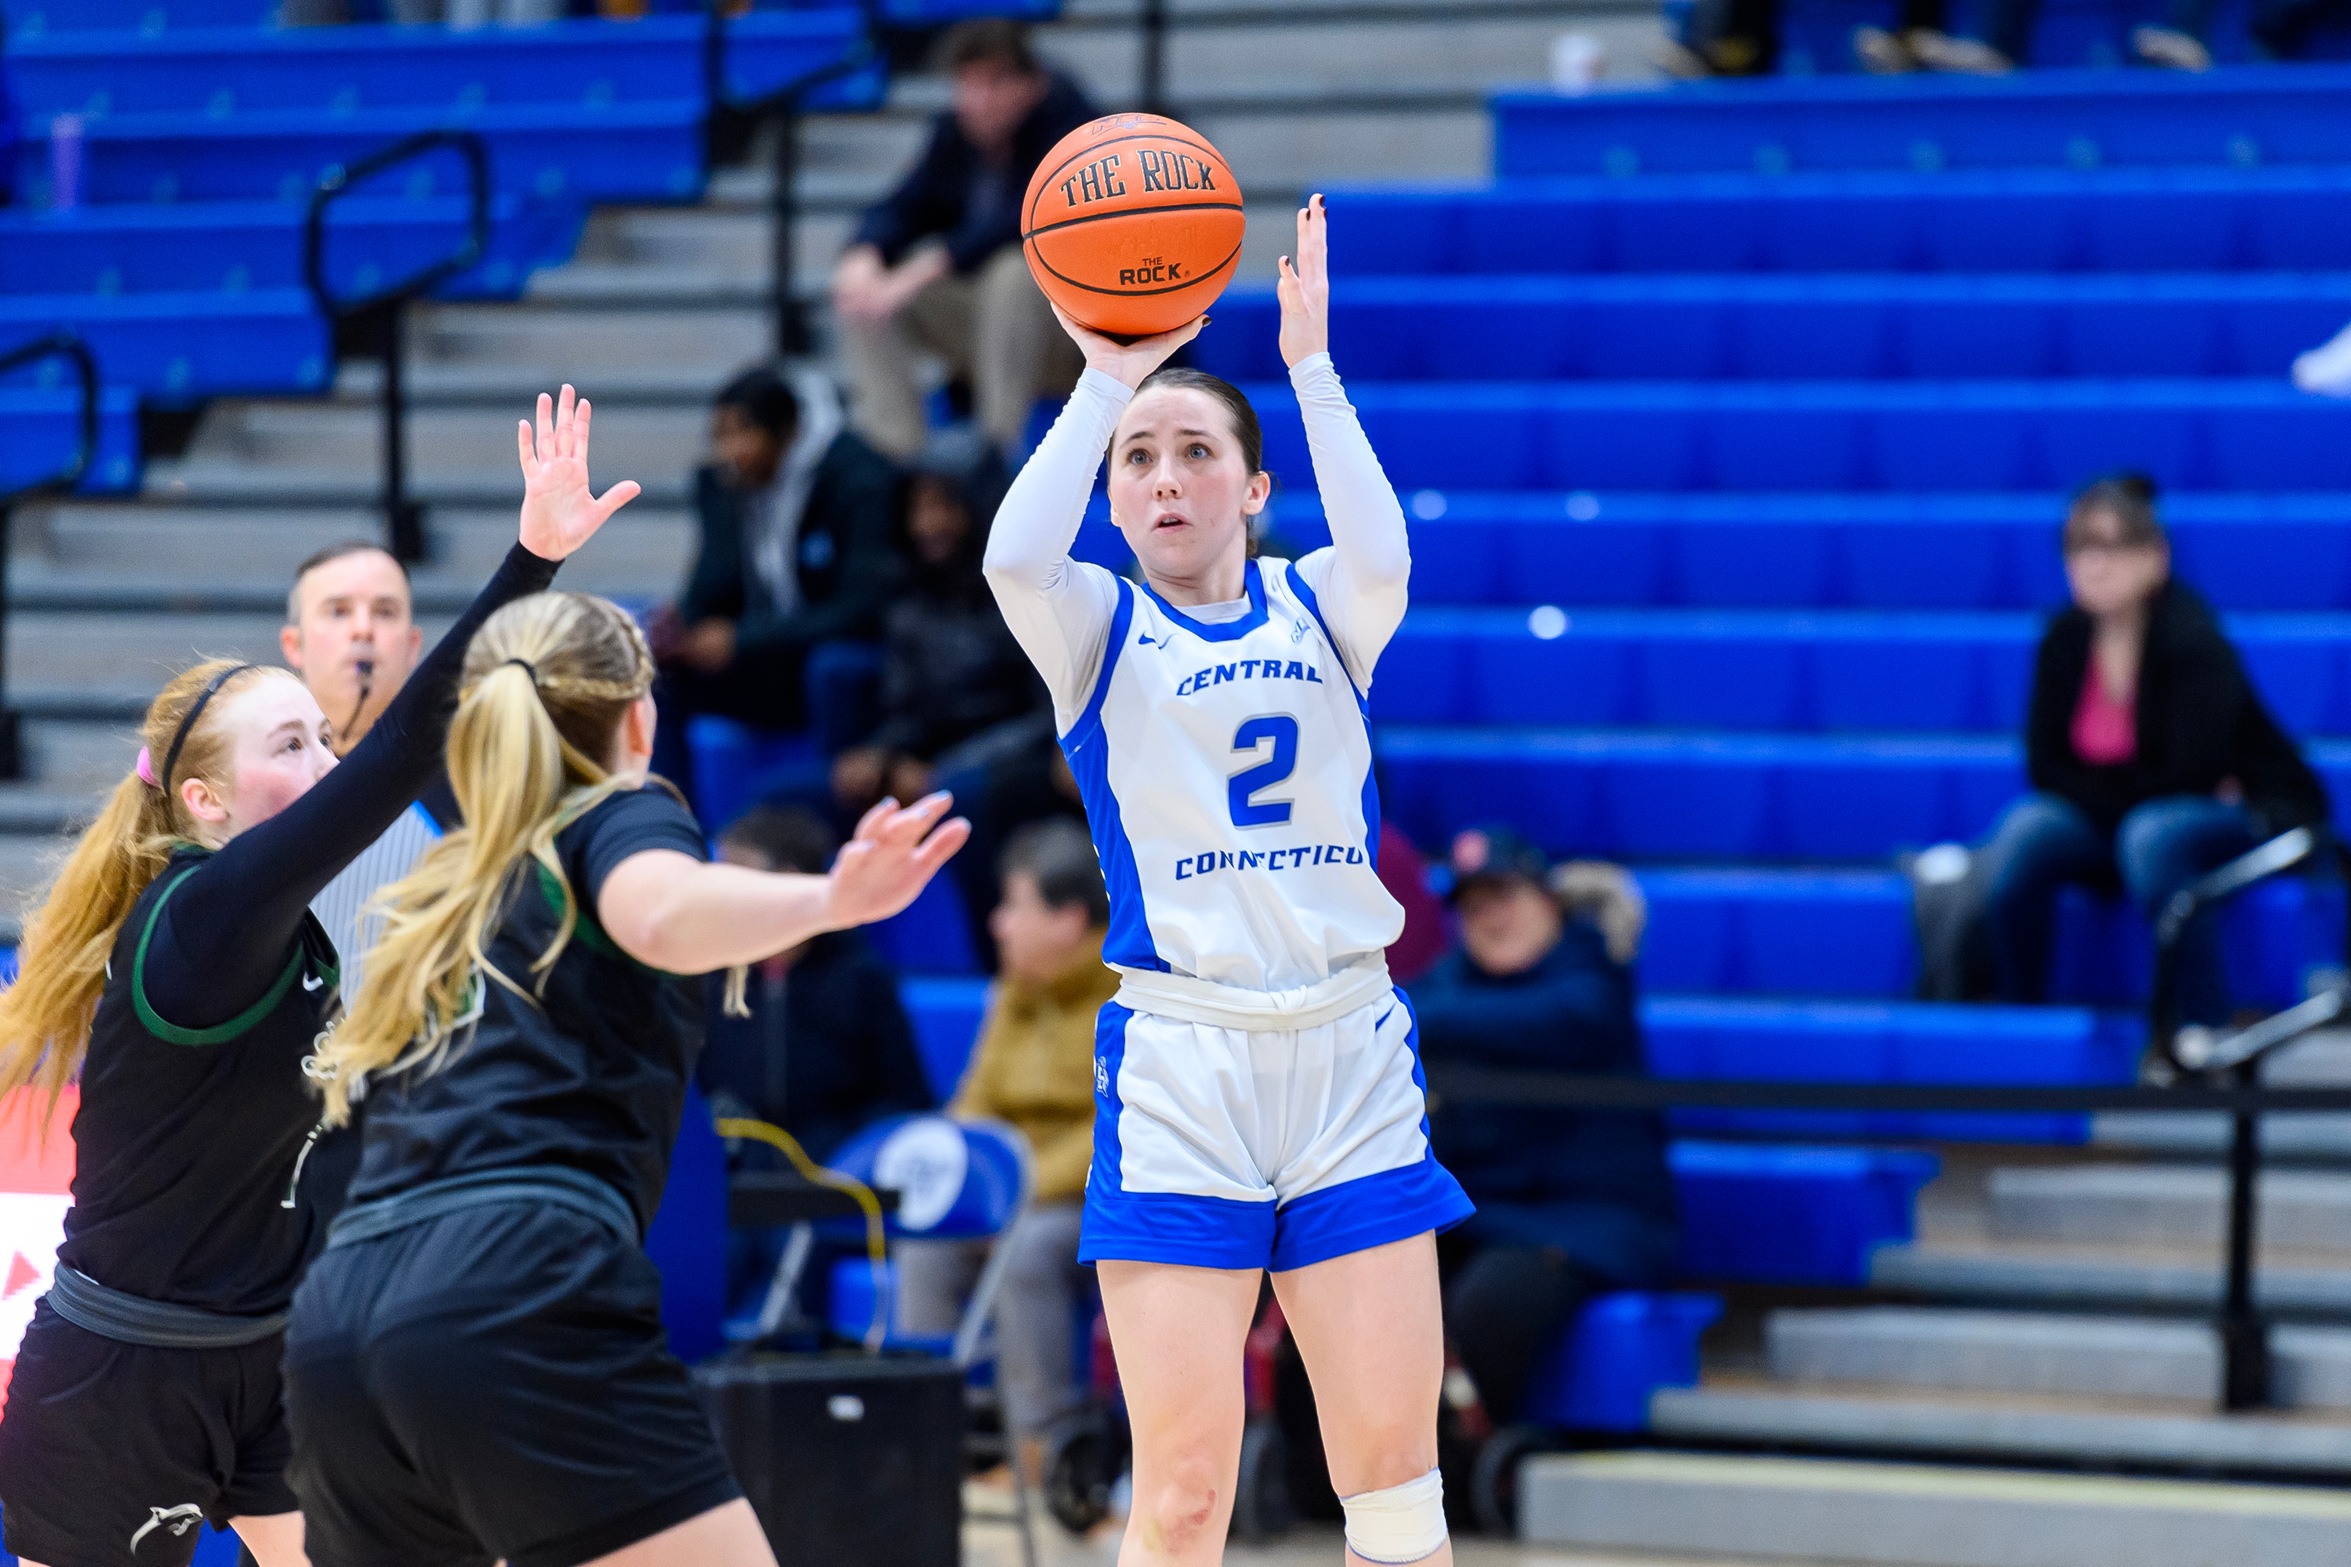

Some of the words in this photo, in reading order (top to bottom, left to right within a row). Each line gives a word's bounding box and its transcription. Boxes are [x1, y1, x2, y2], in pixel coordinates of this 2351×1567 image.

[1060, 153, 1127, 208] THE
[1136, 149, 1217, 193] ROCK
[1142, 256, 1163, 267] THE
[1176, 659, 1323, 696] CENTRAL
[1226, 711, 1301, 831] 2
